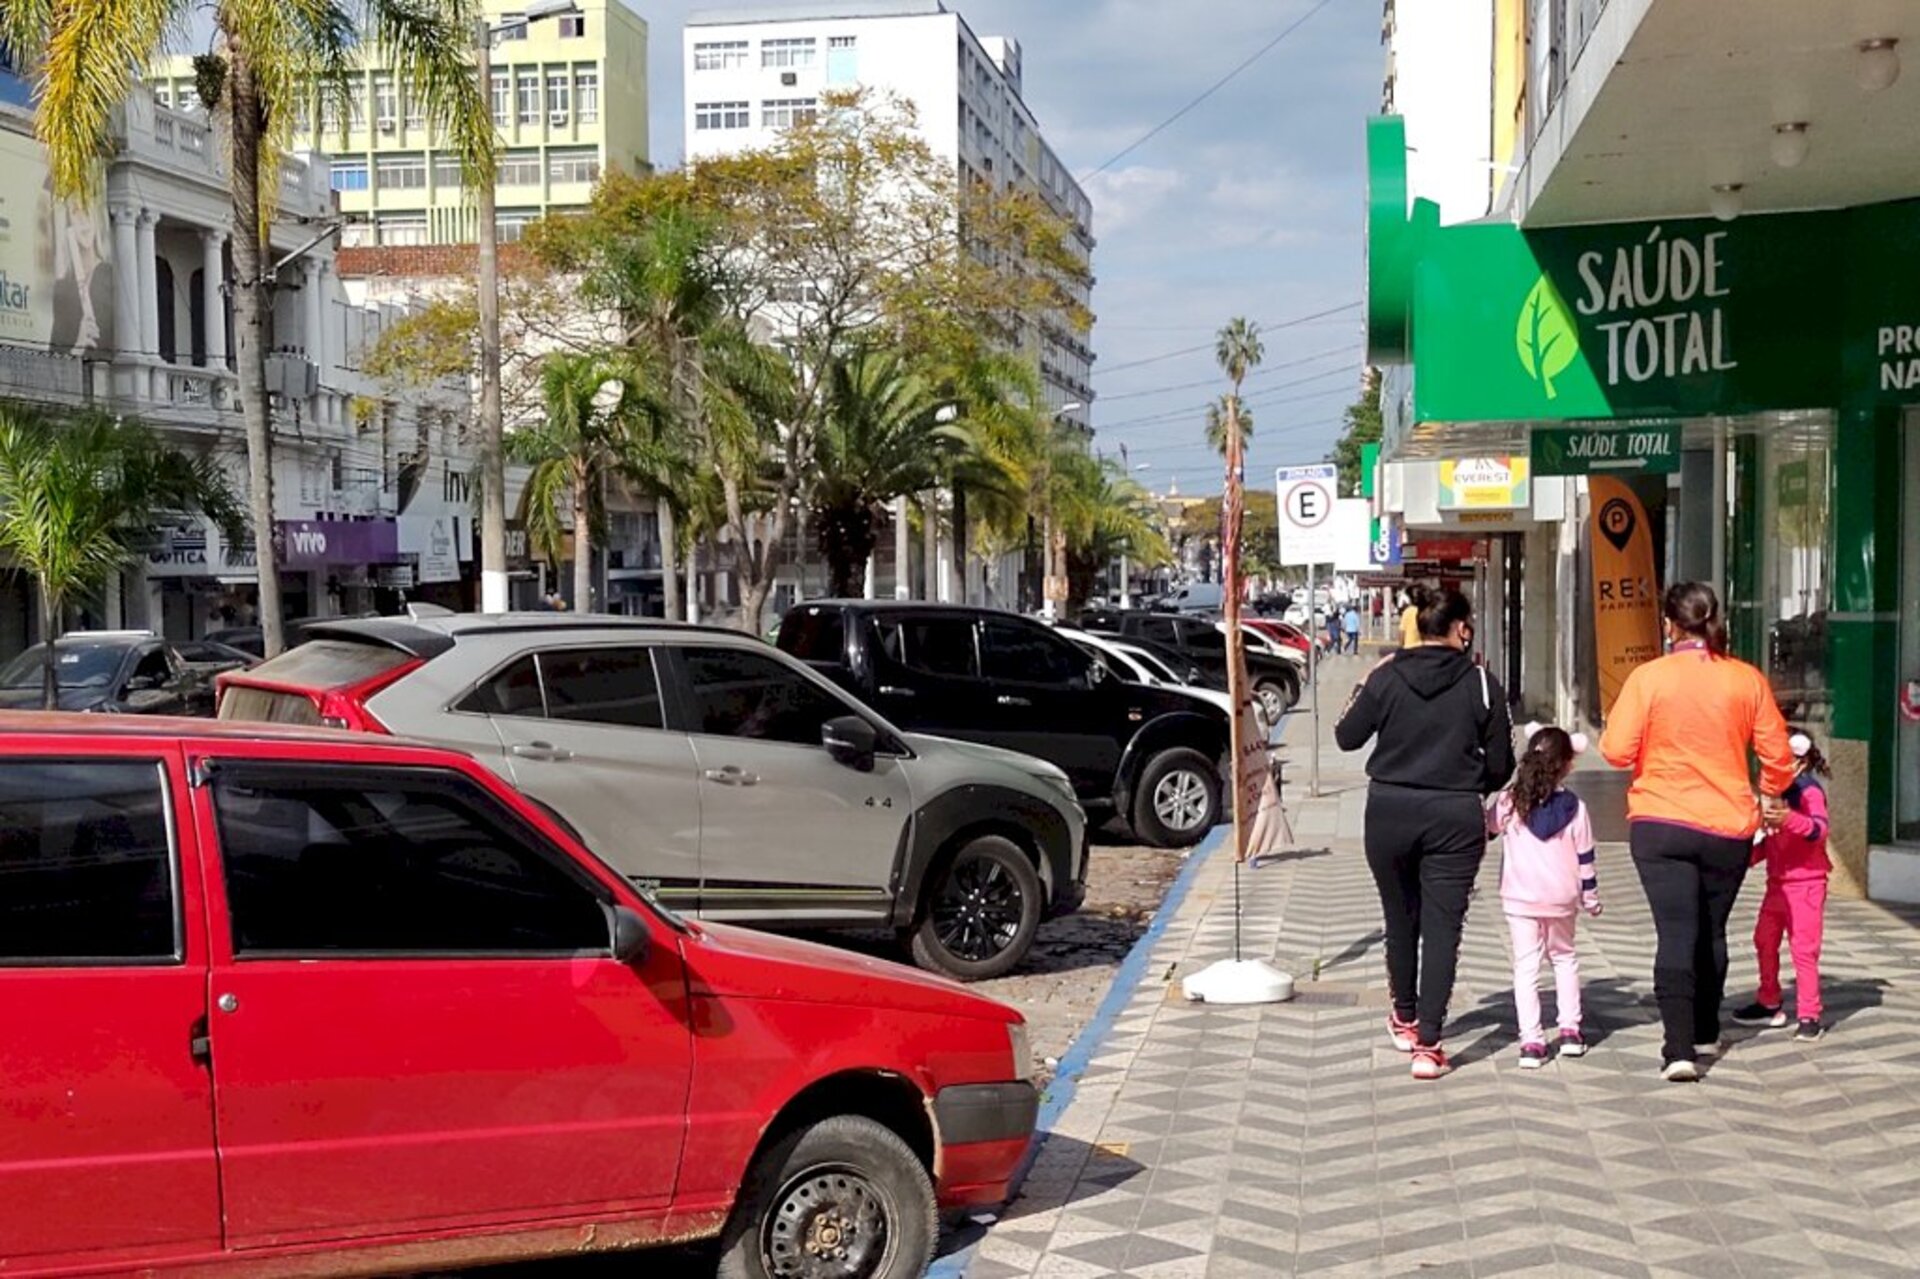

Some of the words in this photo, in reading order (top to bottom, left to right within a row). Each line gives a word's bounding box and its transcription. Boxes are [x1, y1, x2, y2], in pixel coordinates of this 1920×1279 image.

[1576, 225, 1730, 315] SAÚDE
[1595, 308, 1738, 385] TOTAL
[1566, 432, 1619, 457] SAÚDE
[1627, 433, 1671, 455] TOTAL
[1454, 472, 1509, 484] EVEREST
[1300, 491, 1316, 518] E
[1612, 511, 1624, 528] P
[292, 523, 327, 553] vivo
